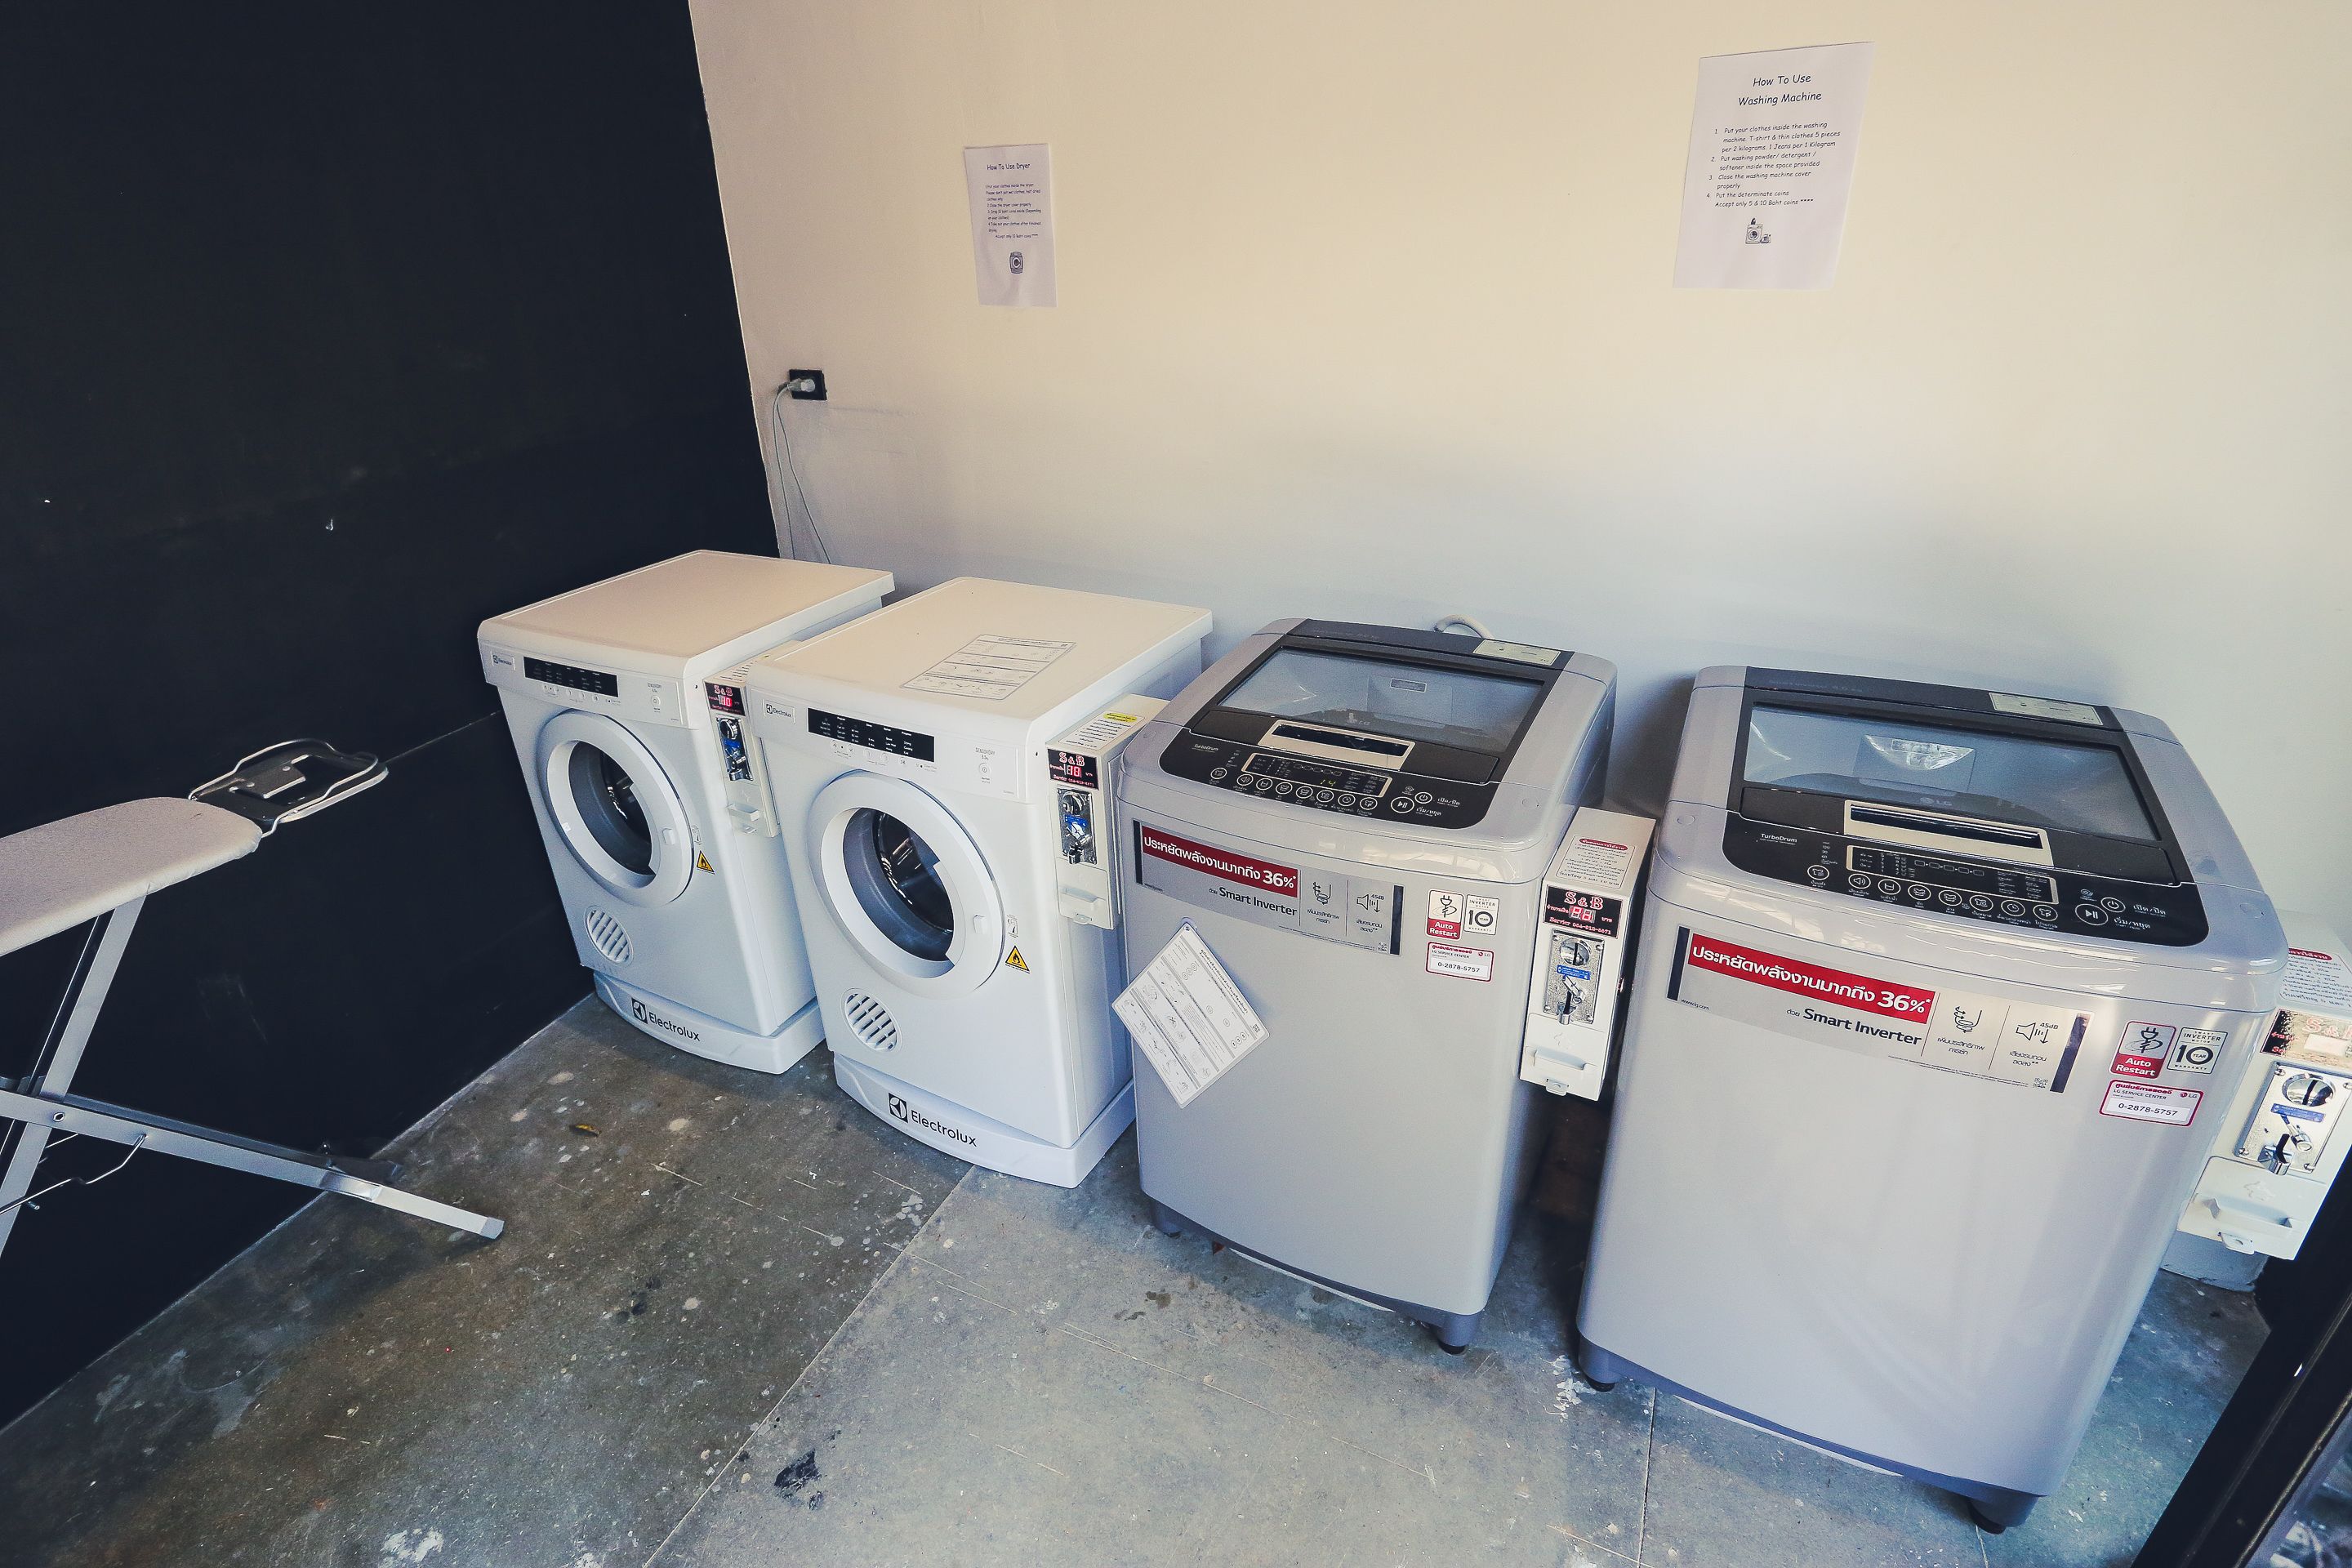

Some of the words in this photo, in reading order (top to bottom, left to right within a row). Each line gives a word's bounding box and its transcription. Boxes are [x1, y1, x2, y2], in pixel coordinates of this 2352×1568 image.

[1753, 78, 1773, 87] How
[1777, 75, 1789, 85] To
[1793, 74, 1811, 83] Use
[1739, 96, 1778, 106] Washing
[1781, 92, 1822, 103] Machine
[1809, 140, 1836, 149] Kilogram
[1731, 154, 1753, 162] washing
[1745, 172, 1768, 180] washing
[1761, 833, 1797, 843] TurboDrum
[1144, 836, 1261, 880] ประหยัดพลังงานมากถึง
[1219, 886, 1251, 905] Smart
[1253, 897, 1298, 916] Inverter
[2133, 904, 2166, 915] เปิด/ปิด
[1468, 910, 1494, 927] 10
[2114, 916, 2150, 929] เริ่ม/หยุด
[1434, 921, 1454, 930] Auto
[1429, 928, 1458, 938] Restart
[1437, 961, 1480, 973] 0-2878-5757
[1692, 946, 1876, 1002] ประหยัดพลังงานมากถึง
[1681, 999, 1710, 1011] www.lg.com
[649, 1012, 701, 1042] Electrolux
[1803, 1008, 1852, 1030] Smart
[1855, 1021, 1922, 1045] Inverter
[2183, 1033, 2221, 1041] INVERTER
[2176, 1045, 2214, 1065] 10
[2125, 1057, 2151, 1067] Auto
[2115, 1064, 2156, 1076] Restart
[2118, 1102, 2178, 1116] 0-2878-5757
[911, 1109, 977, 1147] Electrolux
